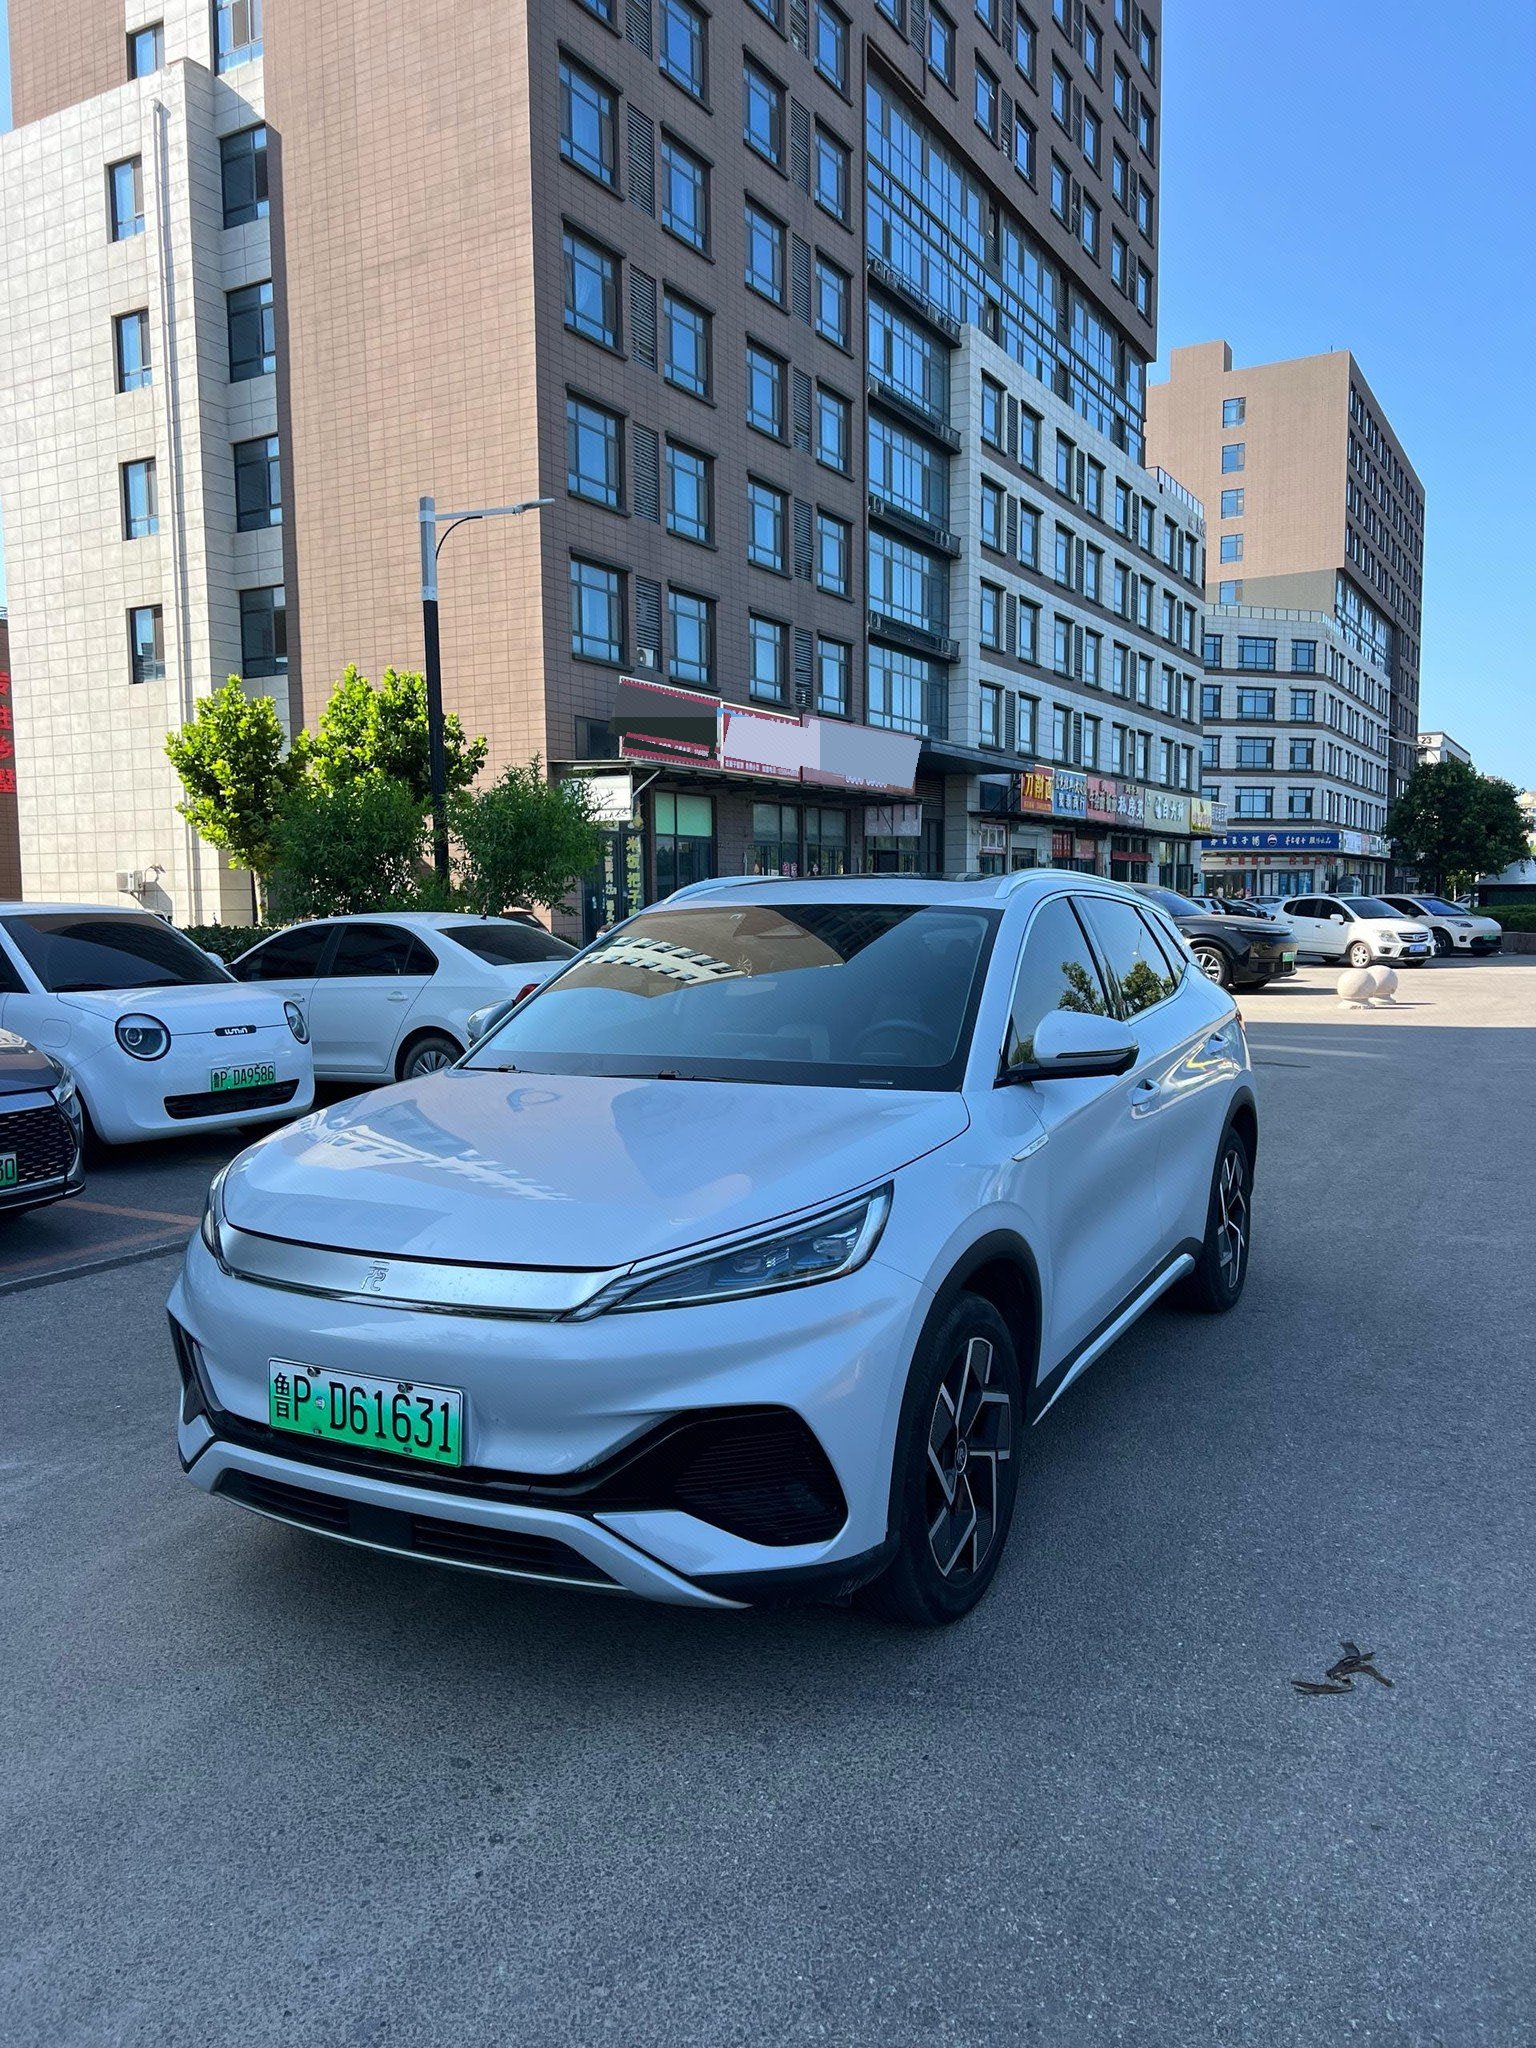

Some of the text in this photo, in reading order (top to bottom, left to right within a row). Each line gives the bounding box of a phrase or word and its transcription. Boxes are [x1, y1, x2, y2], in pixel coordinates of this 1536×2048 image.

[1421, 736, 1432, 744] 23
[1117, 795, 1144, 819] 私房菜
[233, 1065, 274, 1086] DA9586
[329, 1381, 452, 1453] D61631
